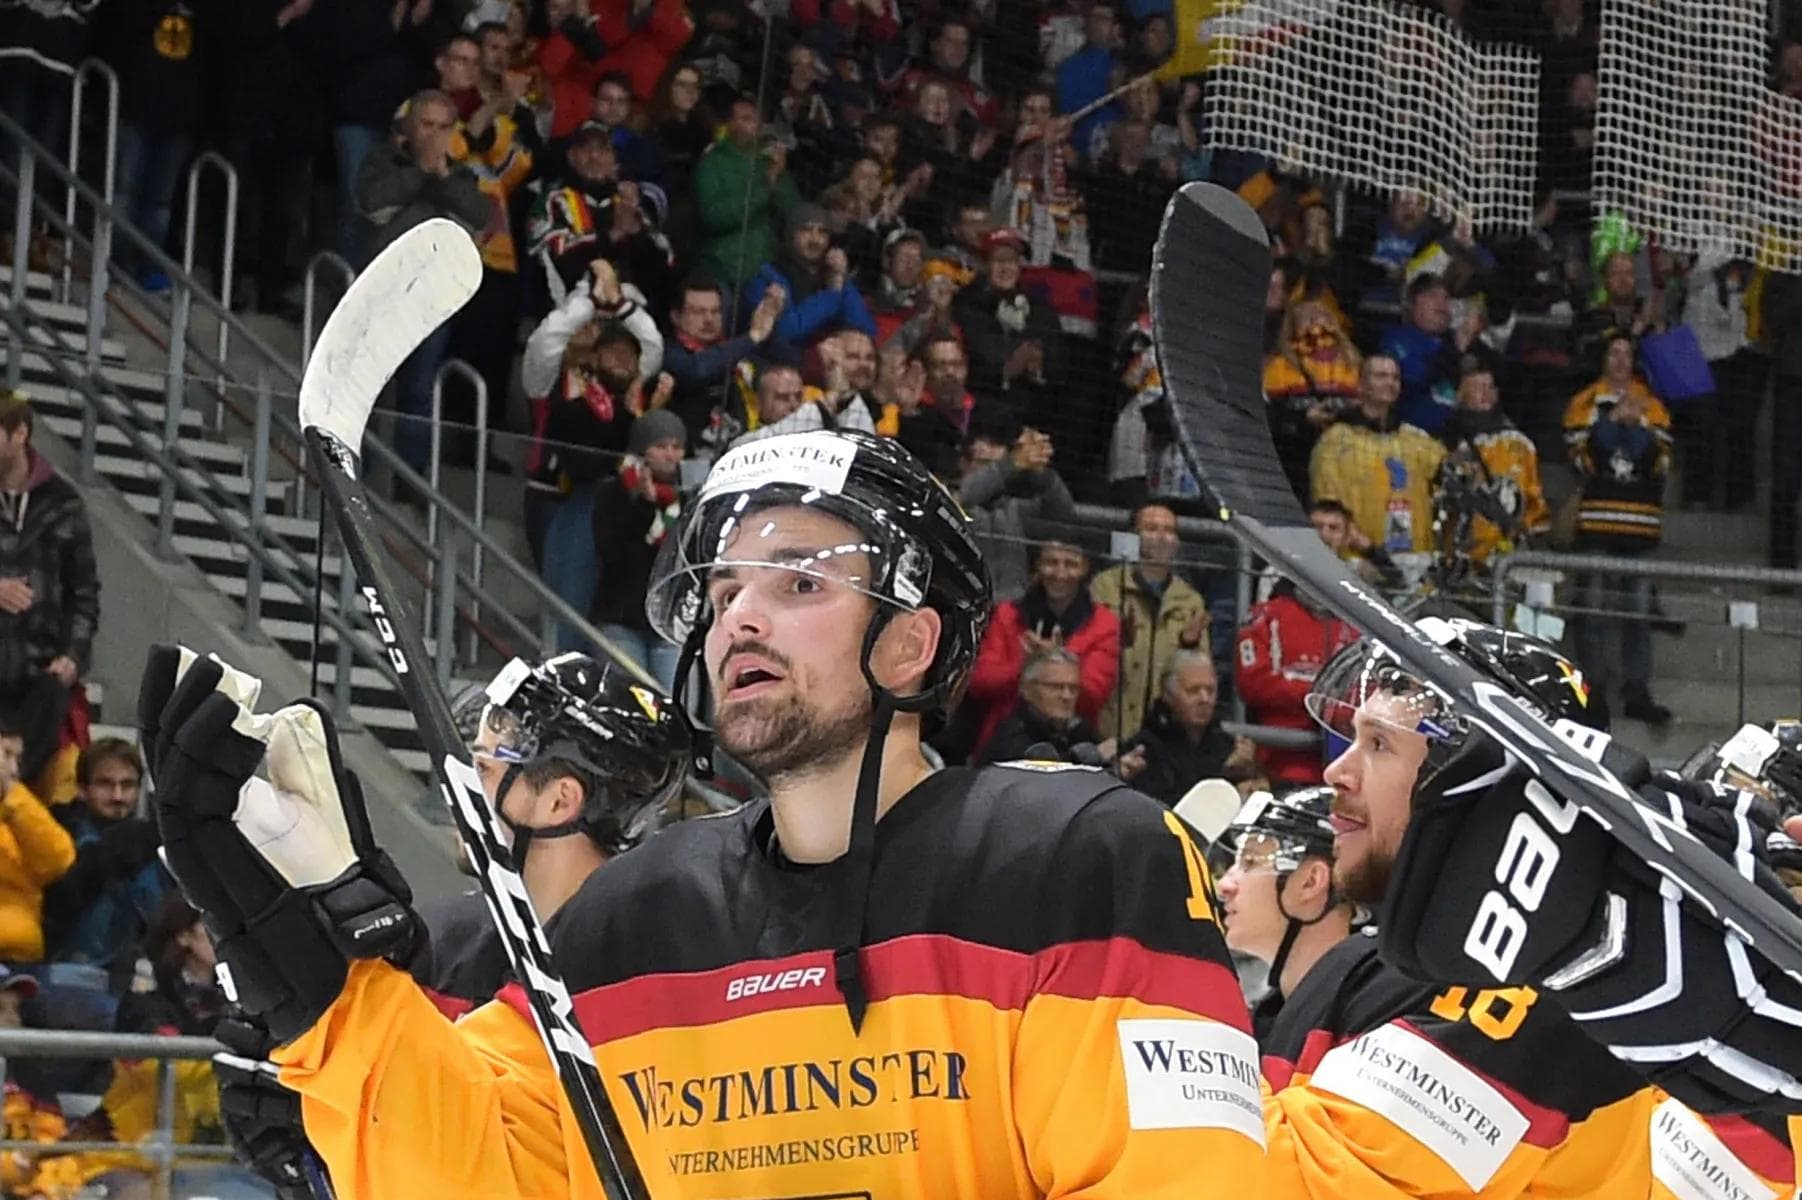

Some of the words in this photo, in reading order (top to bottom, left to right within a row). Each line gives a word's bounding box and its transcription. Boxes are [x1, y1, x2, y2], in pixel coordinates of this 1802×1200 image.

[361, 586, 409, 674] CCM
[443, 753, 599, 1074] CCM
[618, 1049, 972, 1135] WESTMINSTER
[1350, 1036, 1502, 1147] WESTMINSTER
